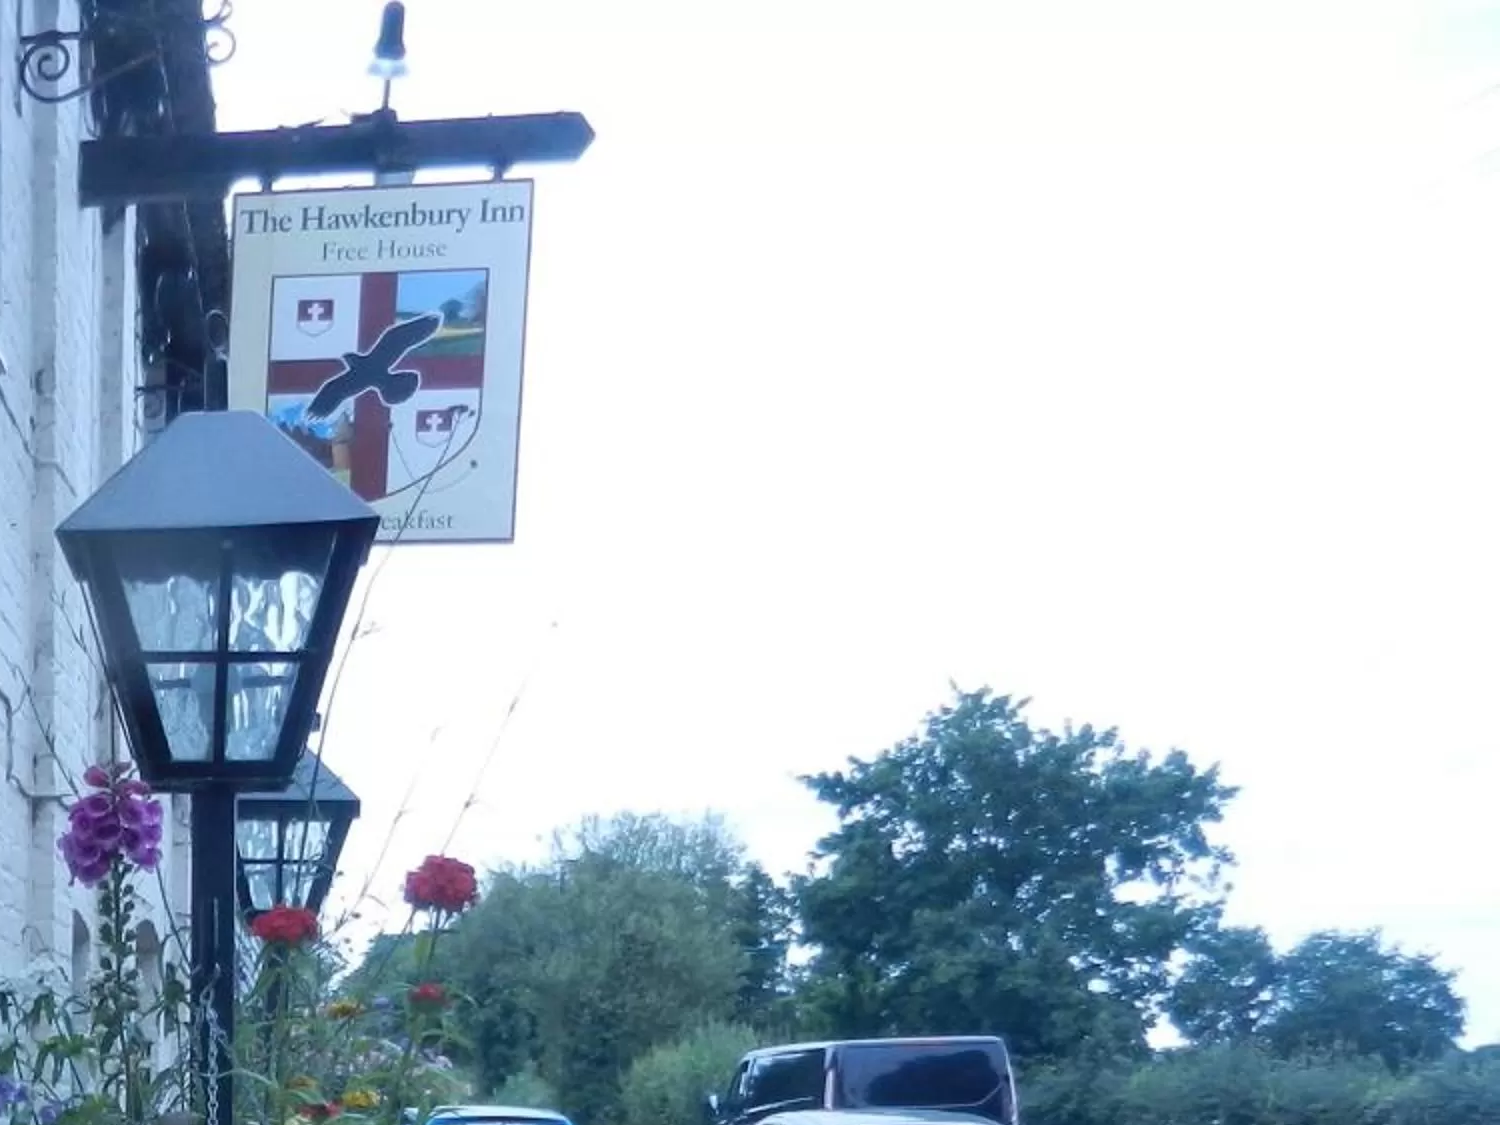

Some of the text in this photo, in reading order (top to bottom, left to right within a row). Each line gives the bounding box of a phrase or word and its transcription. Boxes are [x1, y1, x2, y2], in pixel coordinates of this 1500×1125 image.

[241, 198, 525, 234] The Hawkenbury Inn
[322, 239, 447, 261] Free House
[381, 509, 453, 530] eakfast
